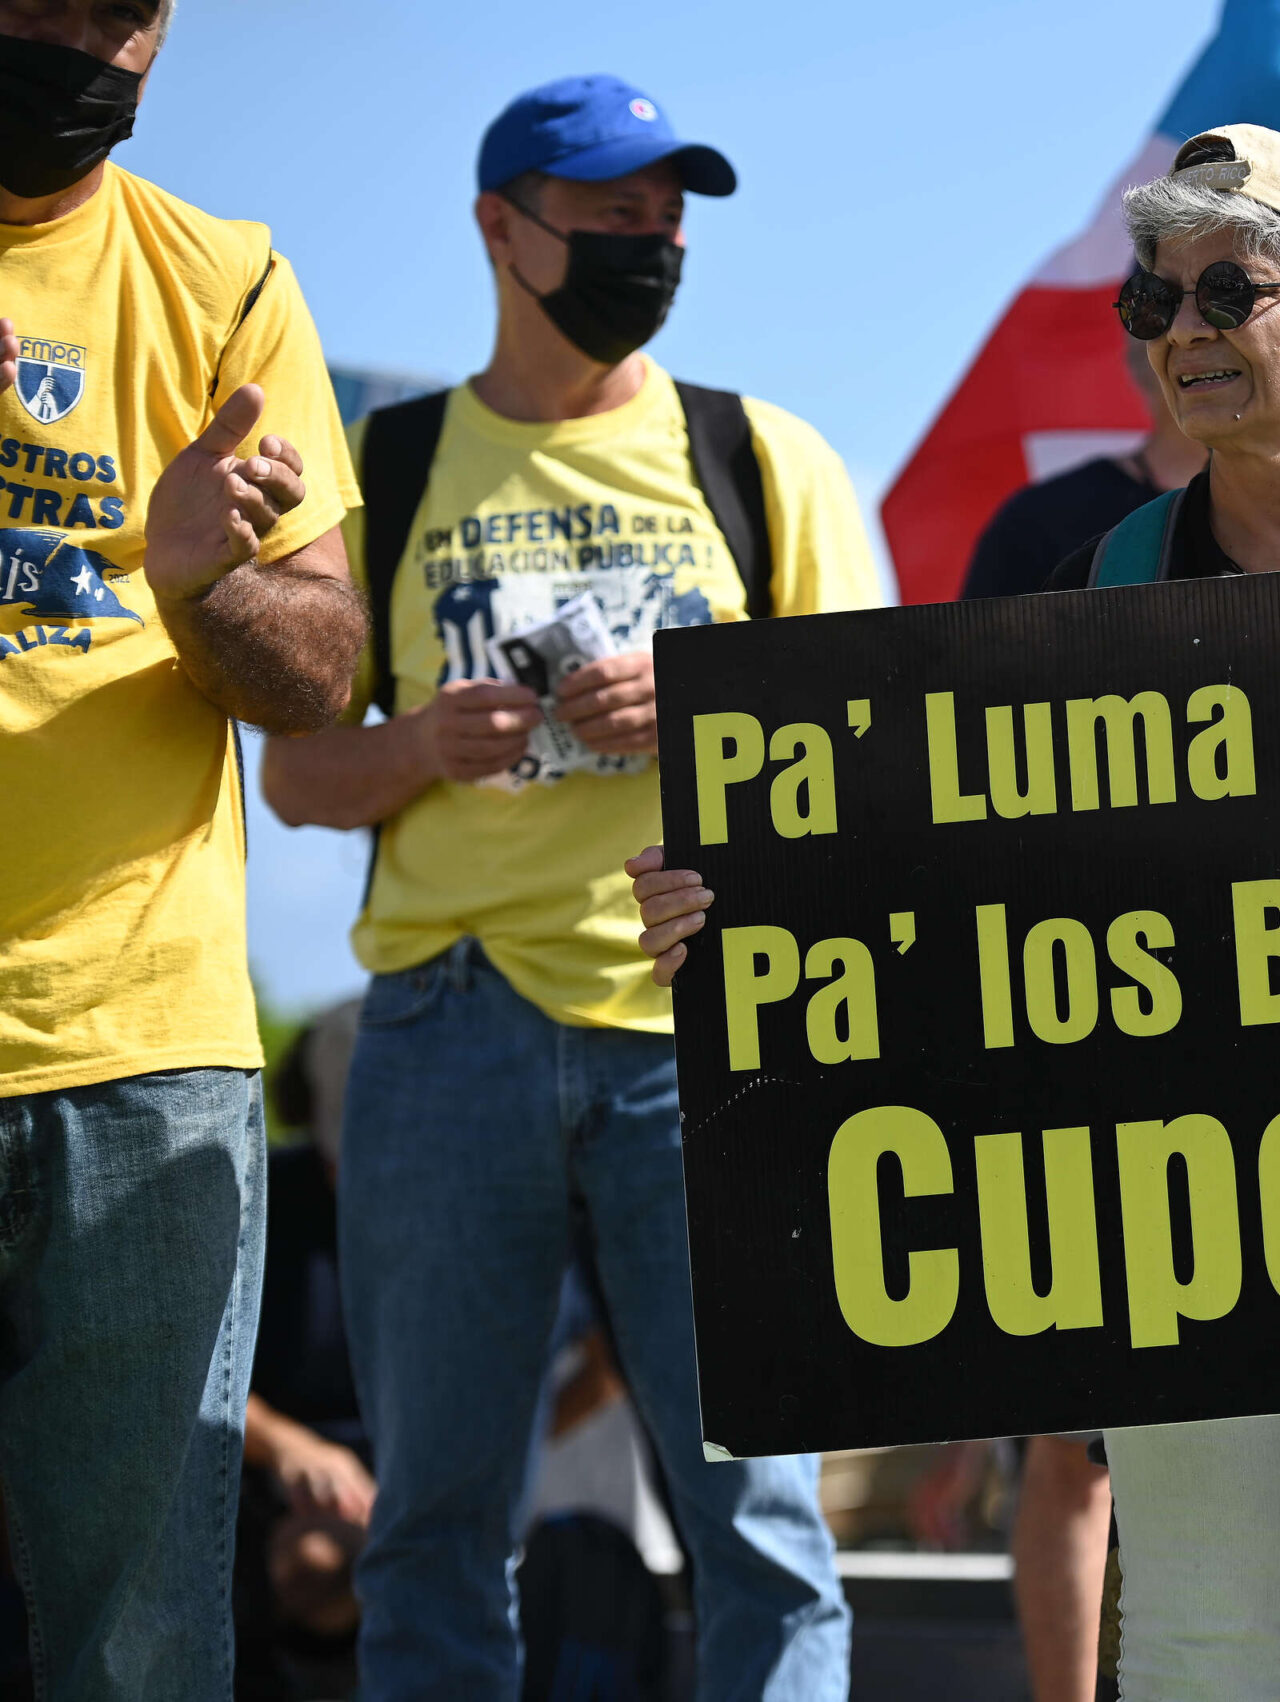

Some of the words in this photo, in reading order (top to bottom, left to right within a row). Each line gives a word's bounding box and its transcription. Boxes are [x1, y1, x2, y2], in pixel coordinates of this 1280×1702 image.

[1220, 166, 1246, 180] RICO
[20, 338, 81, 367] FMPR
[0, 437, 117, 483] STROS
[0, 475, 125, 529] TRAS
[460, 503, 619, 548] DEFENSA
[632, 515, 657, 533] DE
[667, 516, 693, 533] LA
[693, 699, 871, 845] Pa'
[926, 685, 1256, 824] Luma
[722, 912, 915, 1071] Pa'
[976, 904, 1182, 1048] los
